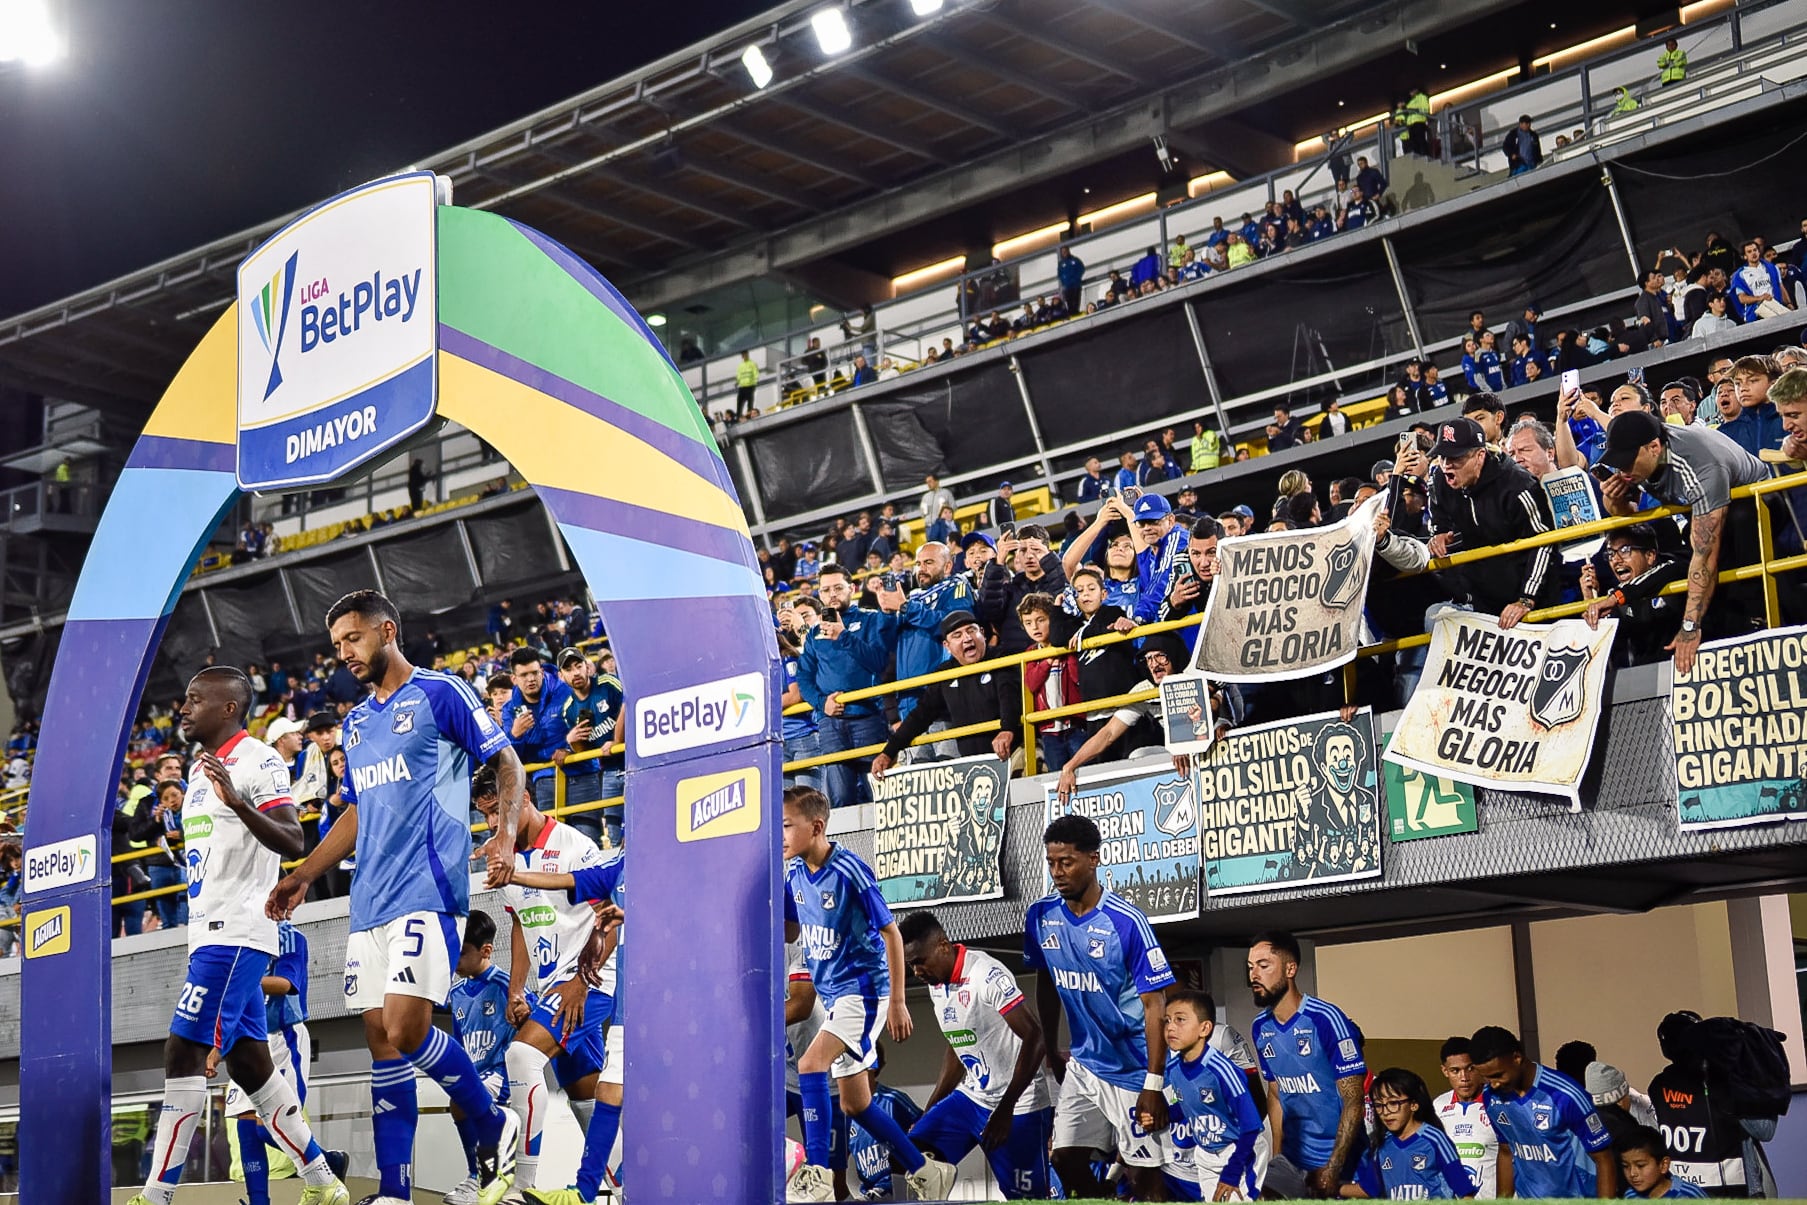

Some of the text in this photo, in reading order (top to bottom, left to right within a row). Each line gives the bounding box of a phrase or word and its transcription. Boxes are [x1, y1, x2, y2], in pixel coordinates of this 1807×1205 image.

[301, 277, 330, 305] LIGA
[301, 268, 422, 354] BetPlay
[286, 405, 378, 464] DIMAYOR
[1550, 482, 1586, 497] BOLSILLO,
[1232, 543, 1316, 578] MENOS
[1226, 572, 1321, 609] NEGOCIO
[1246, 605, 1298, 637] MÁS
[1240, 622, 1342, 668] GLORIA
[1454, 625, 1542, 669] MENOS
[1165, 682, 1195, 692] EL SUELDO
[1437, 659, 1535, 705] NEGOCIO
[644, 696, 728, 739] BetPlay
[1169, 707, 1176, 715] LA
[1449, 698, 1506, 733] MÁS
[1301, 733, 1313, 748] DE
[1437, 728, 1540, 774] GLORIA
[875, 765, 964, 801] DIRECTIVOS DE
[1201, 755, 1318, 803] BOLSILLO,
[692, 782, 743, 830] AGUILA
[875, 791, 966, 831] BOLSILLO,
[1050, 792, 1125, 820] EL SUELDO
[1203, 790, 1298, 830] HINCHADA
[876, 823, 950, 853] HINCHADA
[1098, 836, 1198, 867] ORIA LA DEBEN
[29, 849, 77, 880] BetPlay
[34, 919, 62, 950] AGUILA
[403, 919, 426, 957] 5
[801, 924, 836, 948] NATU
[178, 982, 209, 1014] 26
[948, 1033, 976, 1045] lanta
[1662, 1087, 1694, 1106] WIN
[1190, 1114, 1221, 1133] ATU
[857, 1144, 880, 1168] NAT
[1674, 1164, 1691, 1174] TV
[1013, 1168, 1034, 1192] 15
